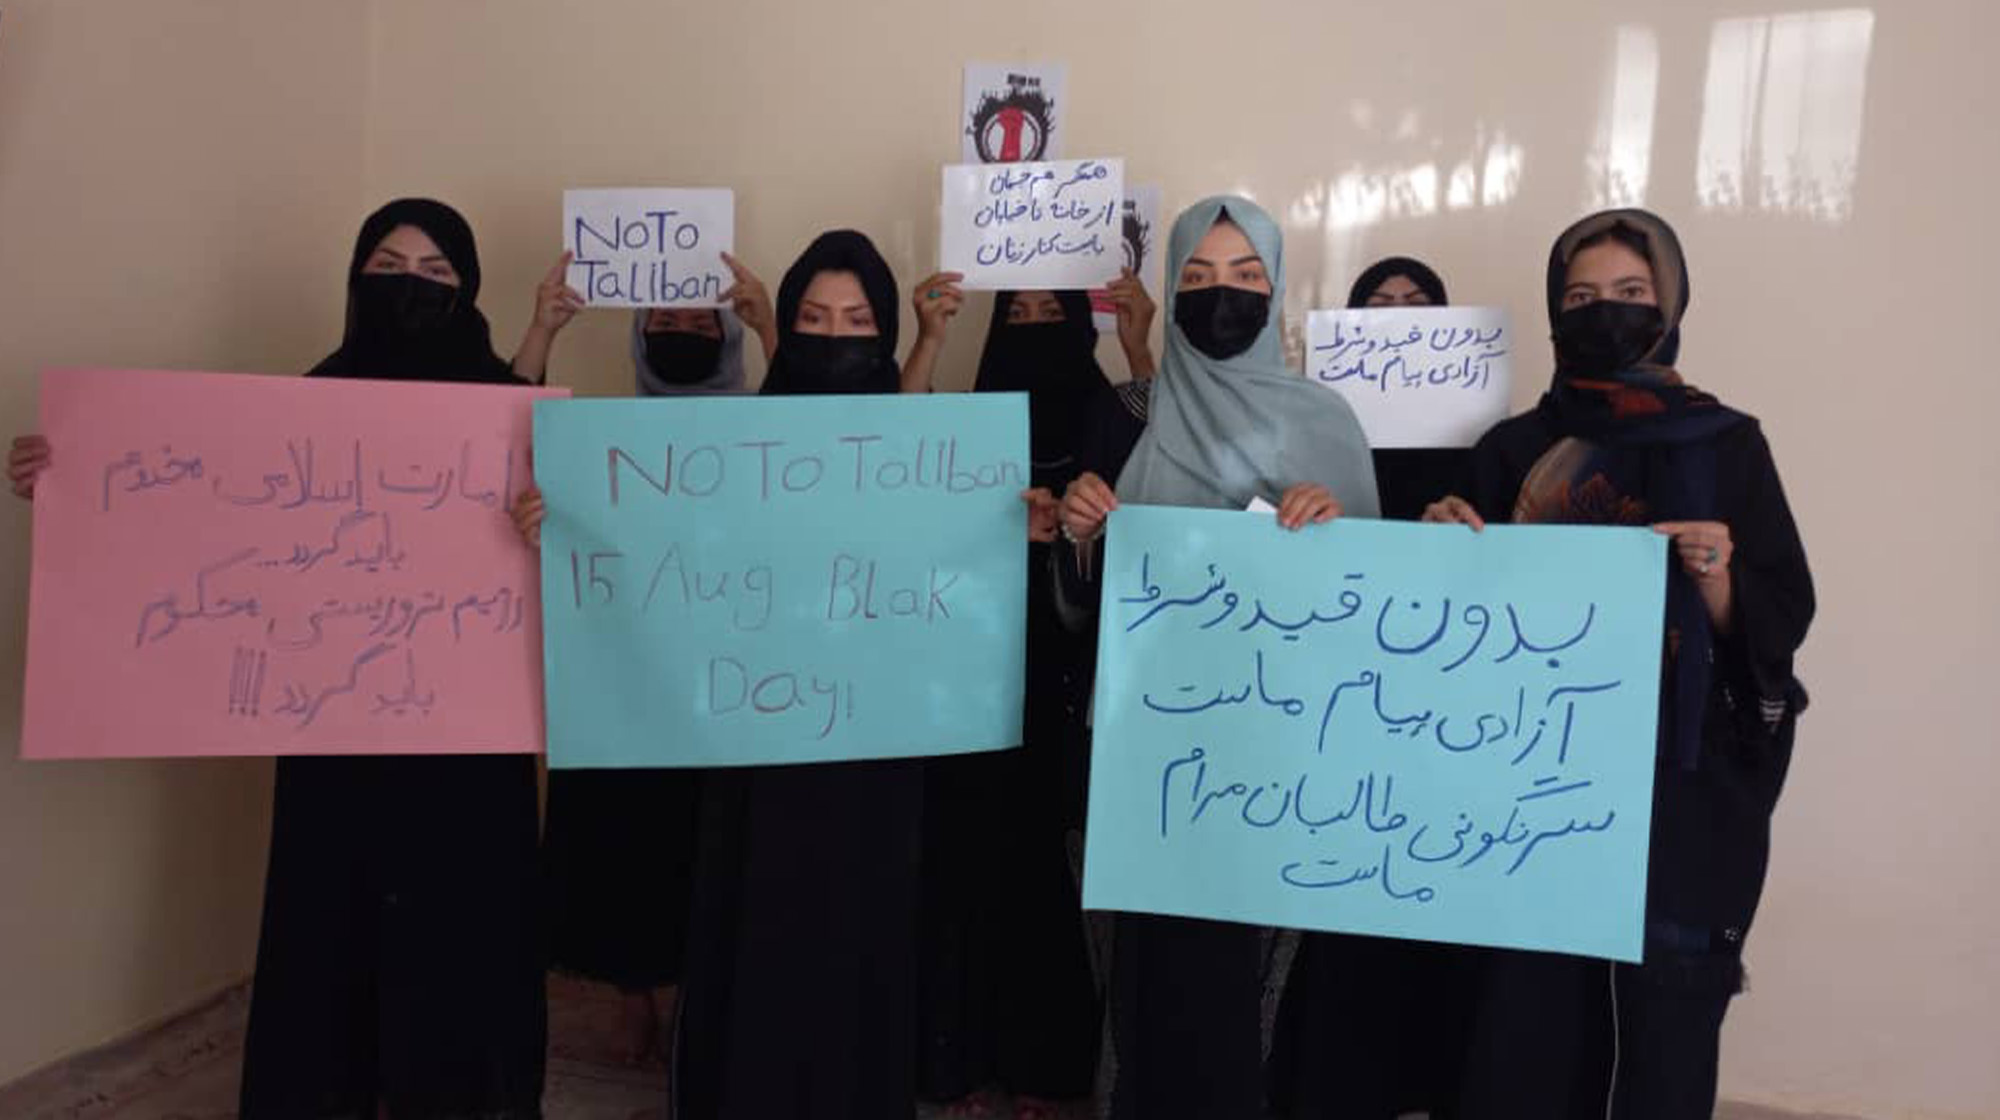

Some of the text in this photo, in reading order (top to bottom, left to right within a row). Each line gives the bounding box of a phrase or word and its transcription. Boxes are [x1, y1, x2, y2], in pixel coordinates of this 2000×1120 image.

[569, 549, 624, 610] 15
[642, 542, 774, 632] Aug
[1239, 572, 1367, 642] قید
[1375, 595, 1596, 672] بدون
[1317, 670, 1433, 755] پیام
[1435, 679, 1623, 766] آزادی
[1241, 771, 1407, 833] طالبان
